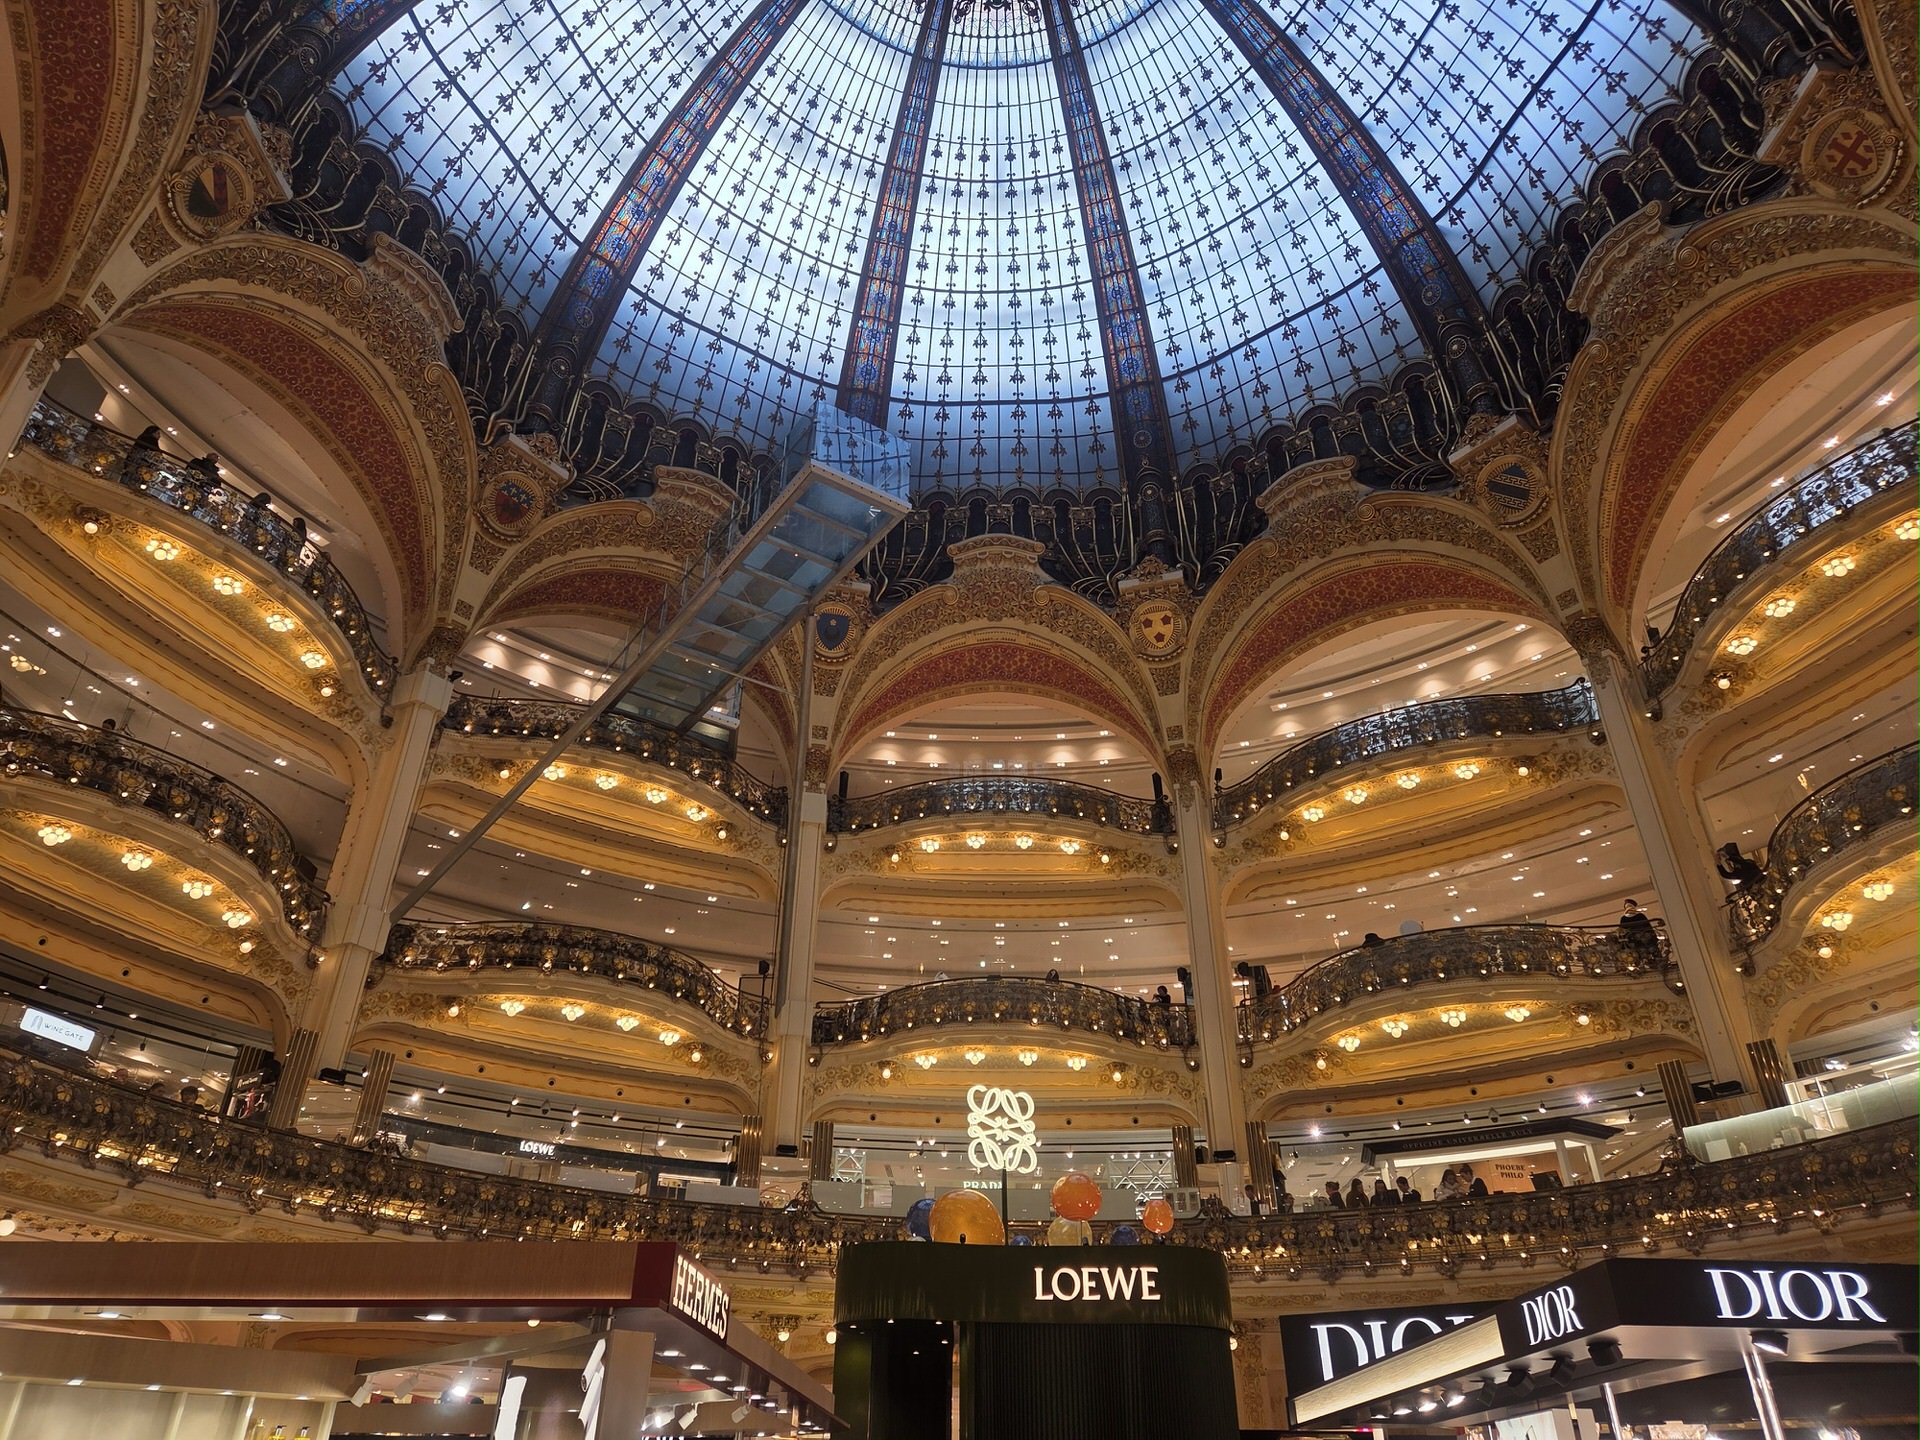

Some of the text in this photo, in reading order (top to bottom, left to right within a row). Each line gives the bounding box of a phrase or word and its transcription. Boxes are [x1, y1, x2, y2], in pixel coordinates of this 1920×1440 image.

[44, 1023, 84, 1041] WINE GATE
[519, 1140, 556, 1156] LOEWE
[1500, 1171, 1524, 1179] PHILO
[672, 1255, 730, 1340] HERMÈS
[1034, 1266, 1161, 1301] LOEWE
[1703, 1268, 1888, 1323] DIOR
[1521, 1285, 1584, 1346] DIOR
